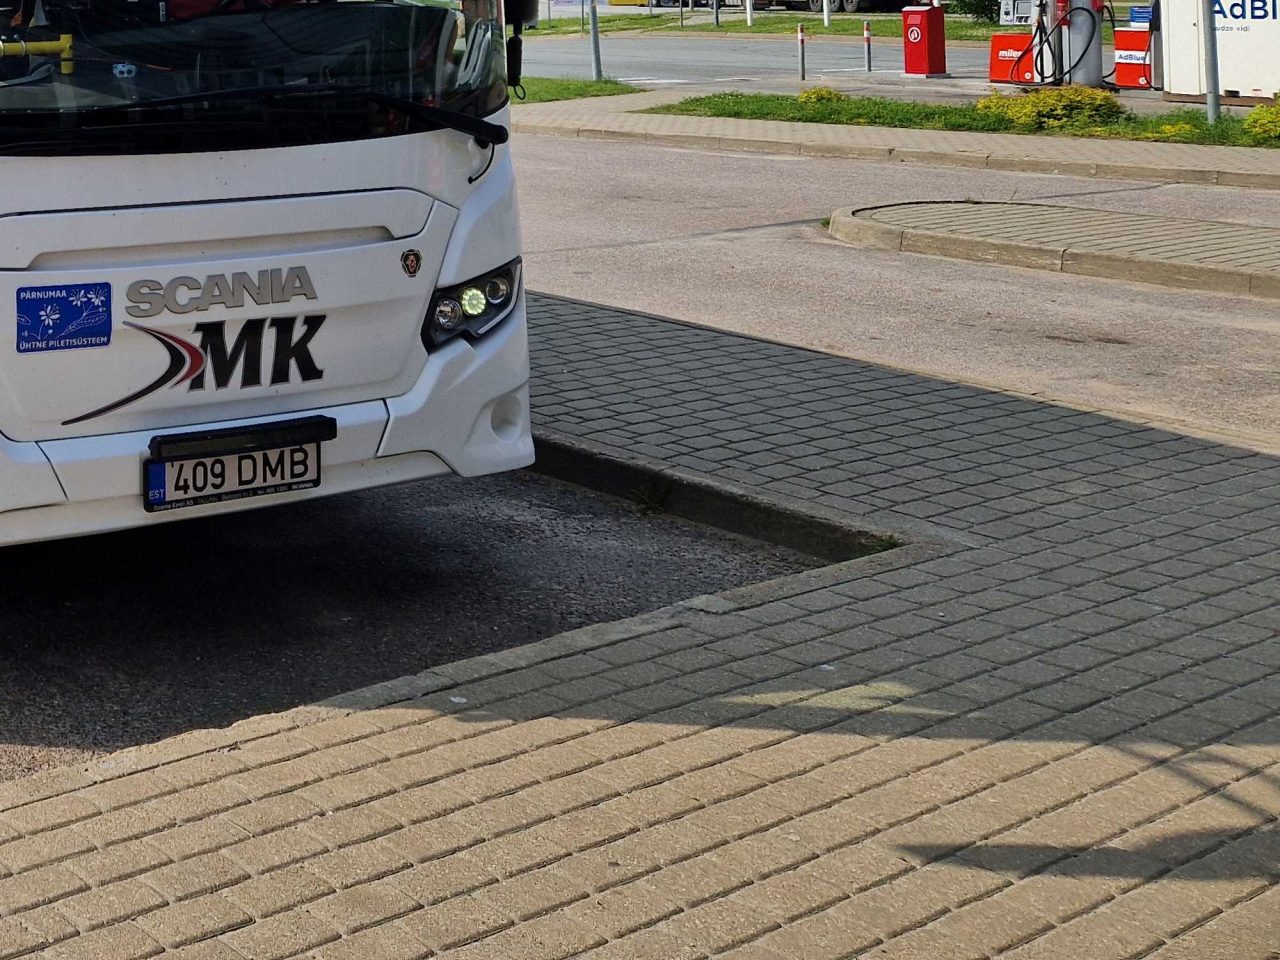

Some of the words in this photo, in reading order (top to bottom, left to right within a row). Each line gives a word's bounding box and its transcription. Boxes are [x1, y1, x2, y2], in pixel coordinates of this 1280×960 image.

[20, 289, 67, 300] PÄRNUMAA
[124, 265, 318, 318] SCANIA
[19, 340, 47, 350] ÜHTNE
[48, 336, 108, 348] PILETISÜSTEEM
[187, 314, 327, 393] MK
[173, 458, 226, 495] 409
[237, 446, 310, 487] DMB
[148, 488, 165, 500] EST
